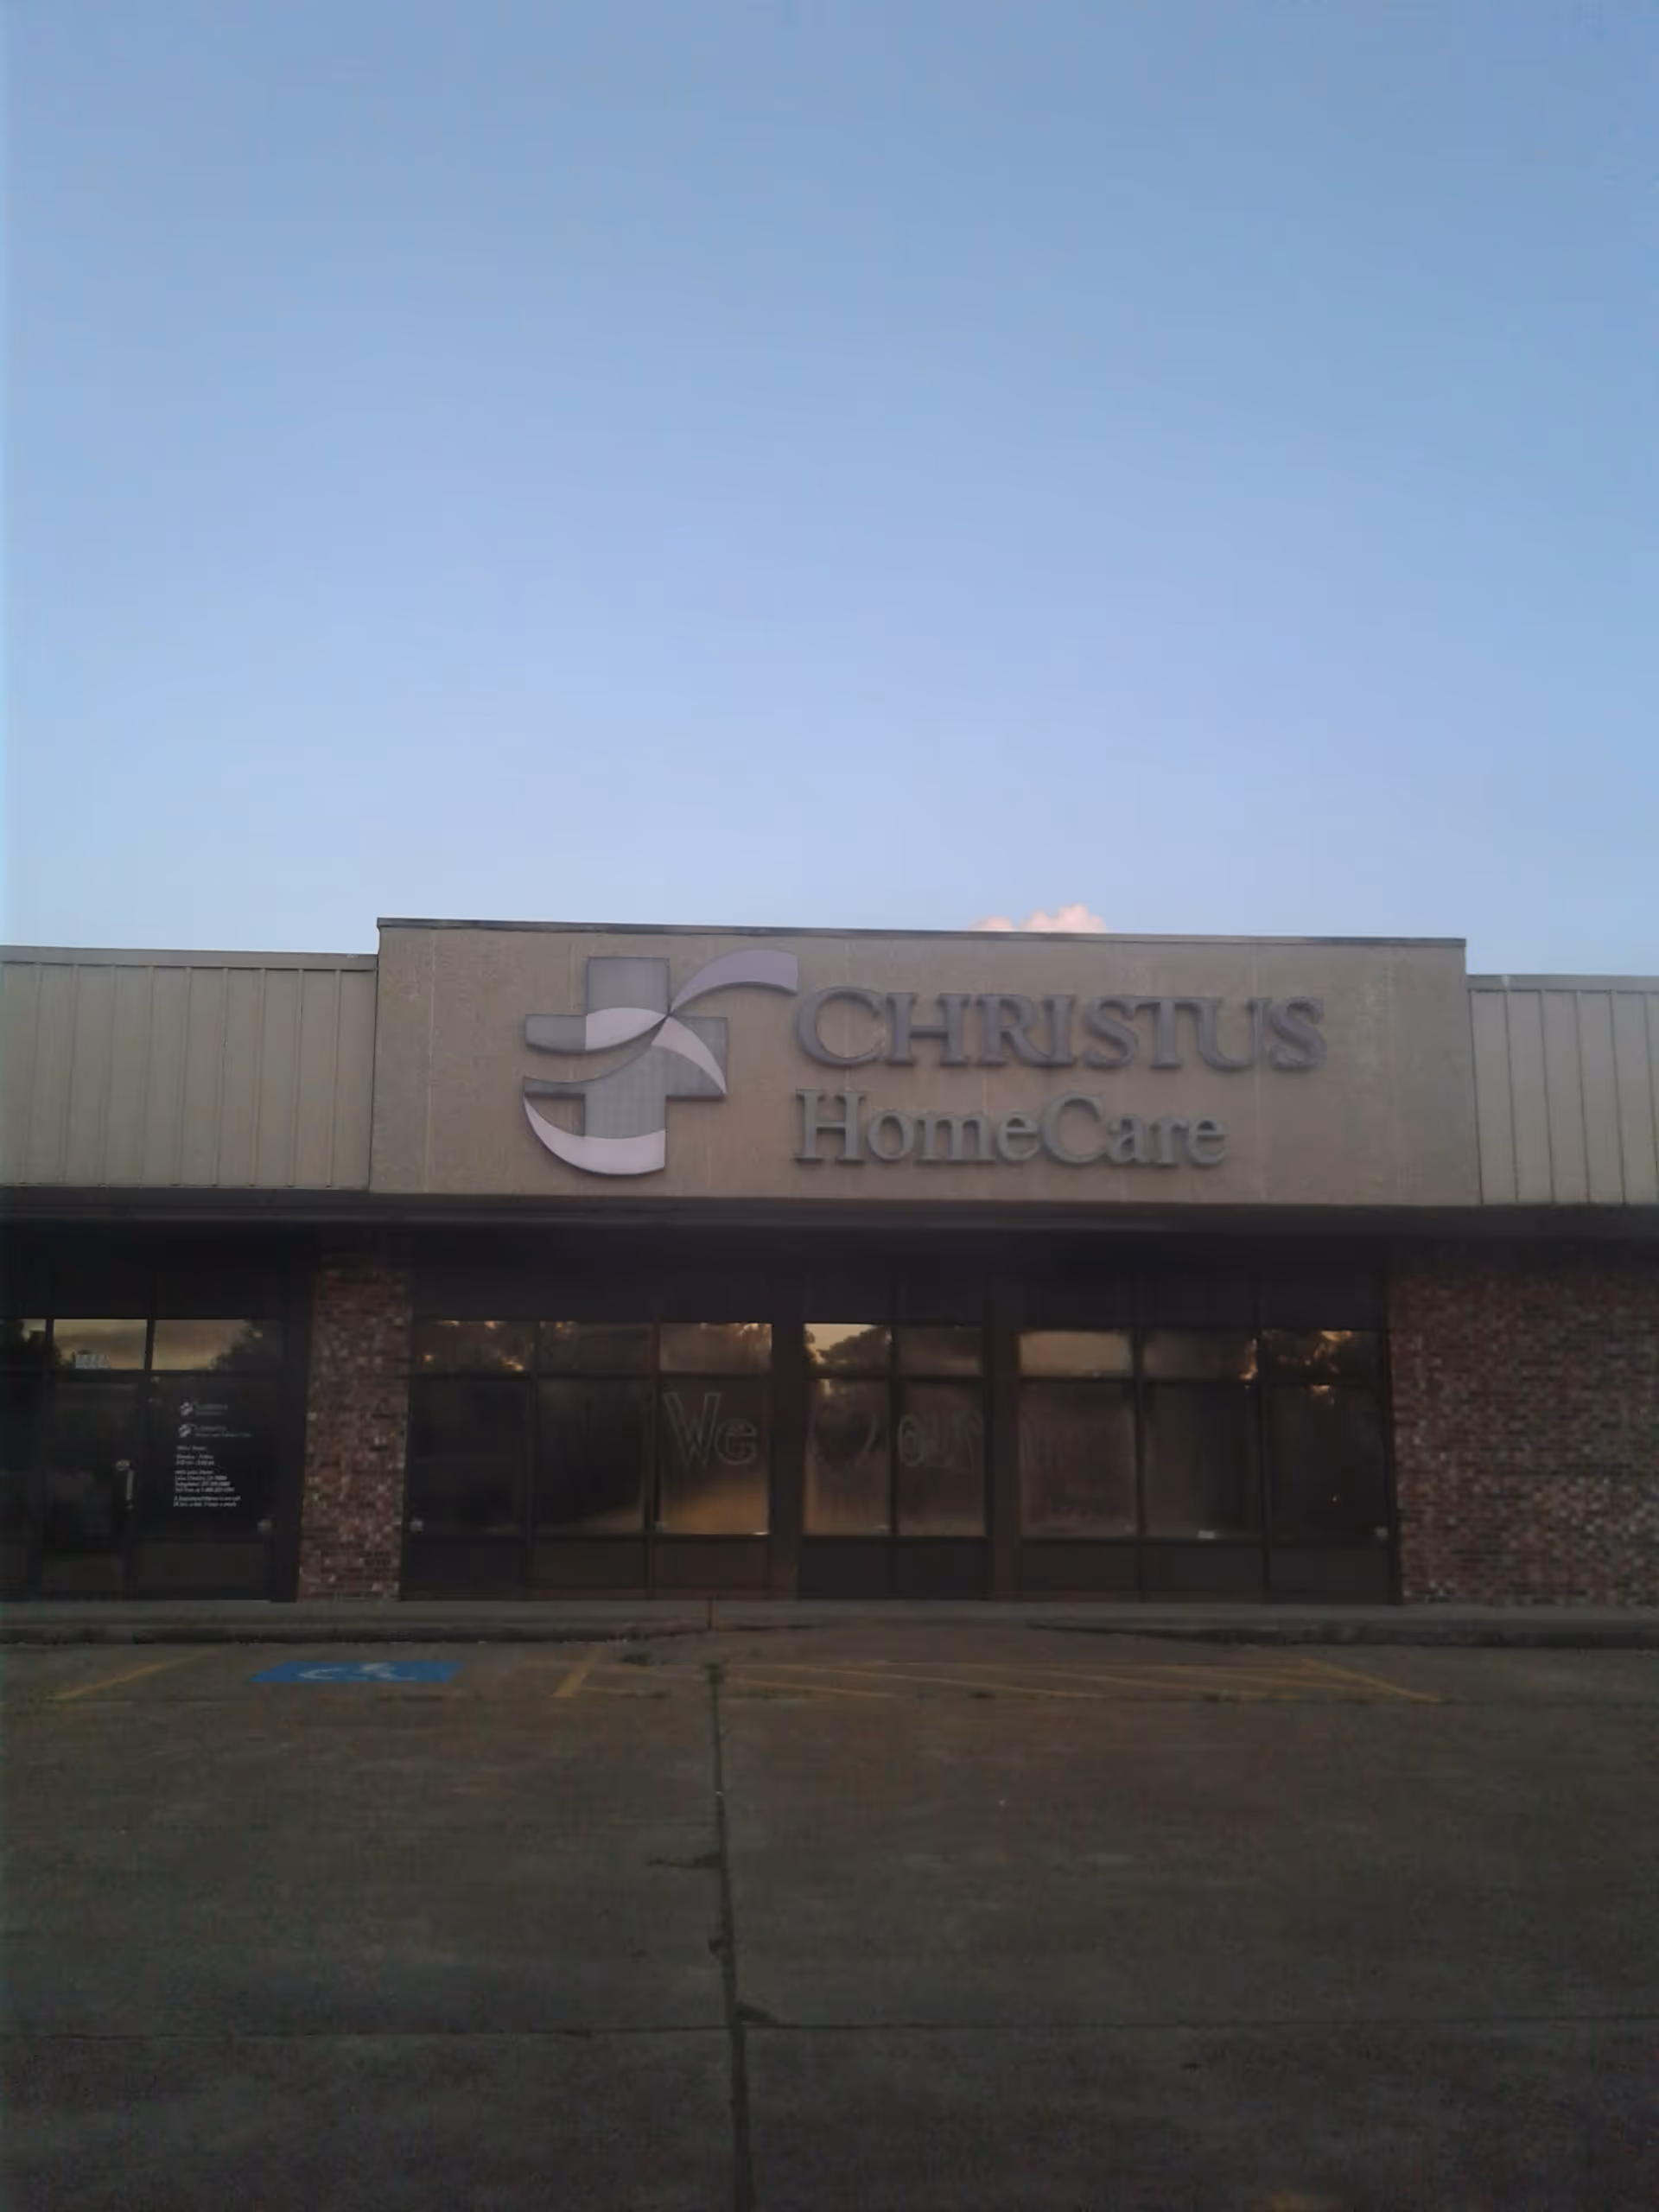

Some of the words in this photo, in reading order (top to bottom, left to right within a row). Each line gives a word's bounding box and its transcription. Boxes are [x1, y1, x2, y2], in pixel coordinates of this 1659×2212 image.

[795, 985, 1327, 1072] CHRISTUS
[794, 1087, 1230, 1166] HomeCare
[663, 1390, 759, 1468] We
